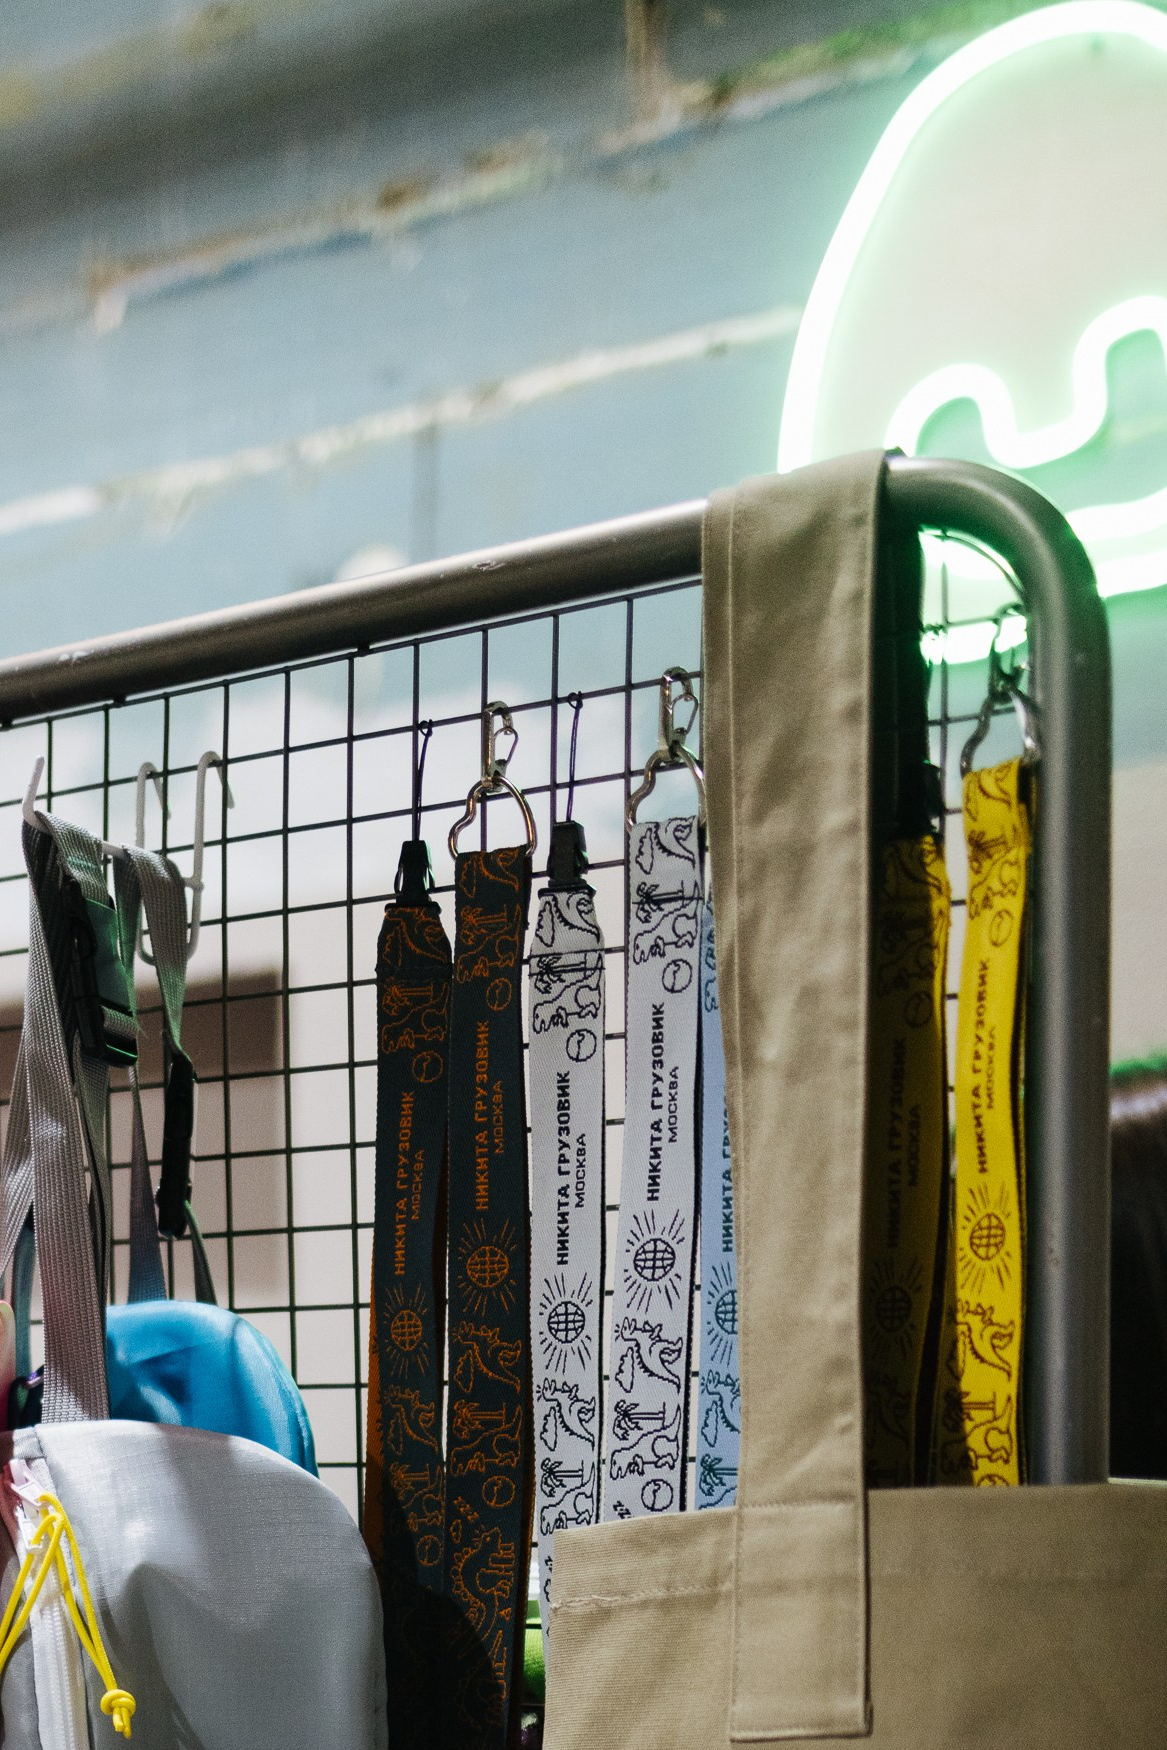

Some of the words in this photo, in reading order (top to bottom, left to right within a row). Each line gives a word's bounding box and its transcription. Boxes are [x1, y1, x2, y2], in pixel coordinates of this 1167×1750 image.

[650, 1002, 665, 1111] ГРУЗОВИК
[971, 959, 989, 1074] ГРУЗОВИК
[474, 1020, 490, 1122] ГРУЗОВИК
[668, 1066, 679, 1143] МОСКВА
[396, 1091, 415, 1190] ГРУЗОВИК
[492, 1080, 504, 1154] МОСКВА
[557, 1070, 571, 1176] ГРУЗОВИК
[971, 1083, 989, 1174] НИКИТА
[411, 1150, 425, 1220] МОСКВА
[475, 1131, 489, 1211] НИКИТА
[574, 1133, 586, 1208] МОСКВА
[646, 1118, 662, 1201] НИКИТА
[395, 1197, 407, 1276] НИКИТА
[557, 1183, 570, 1265] НИКИТА
[722, 1168, 734, 1253] НИКИТА
